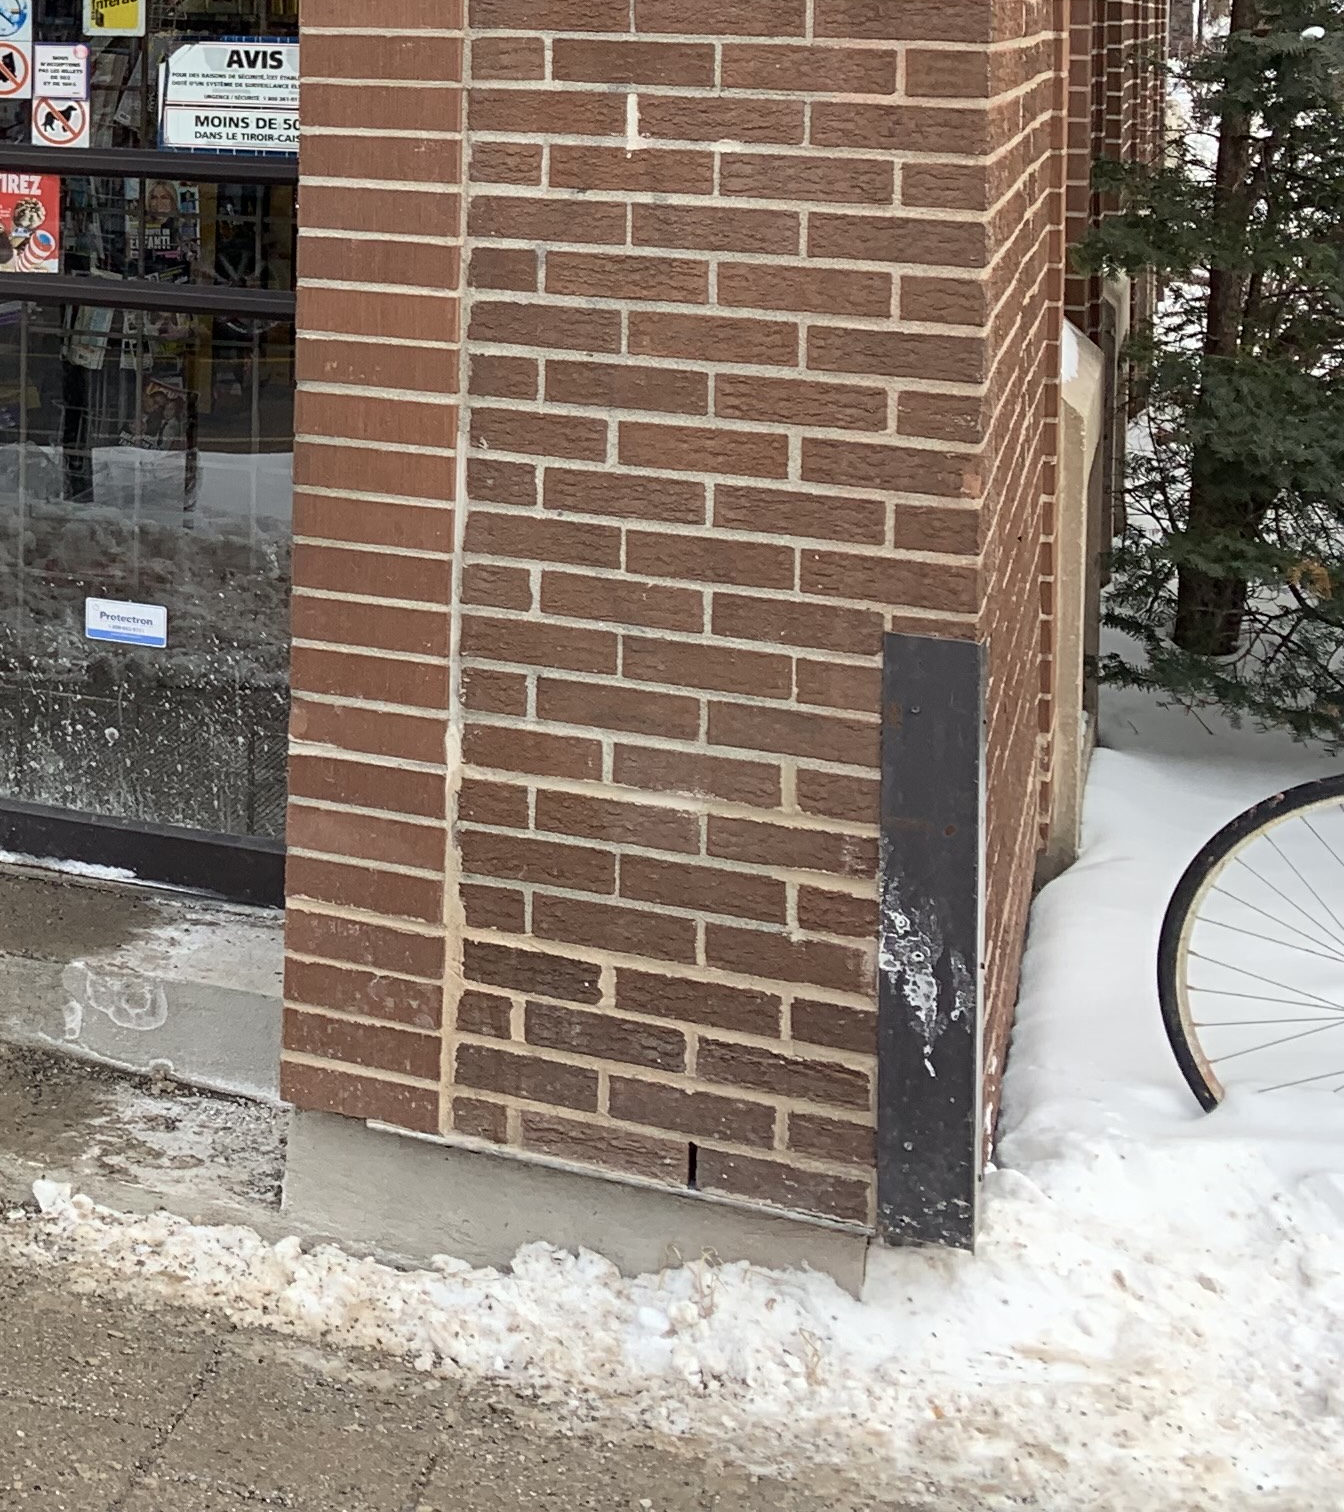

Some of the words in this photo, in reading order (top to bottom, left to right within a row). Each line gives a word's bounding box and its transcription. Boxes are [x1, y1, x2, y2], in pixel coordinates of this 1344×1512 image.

[226, 50, 283, 69] AVIS
[194, 115, 250, 128] MOINS
[255, 117, 278, 130] DE
[194, 131, 222, 140] DANS
[226, 132, 238, 140] LE
[100, 611, 153, 626] Protectron
